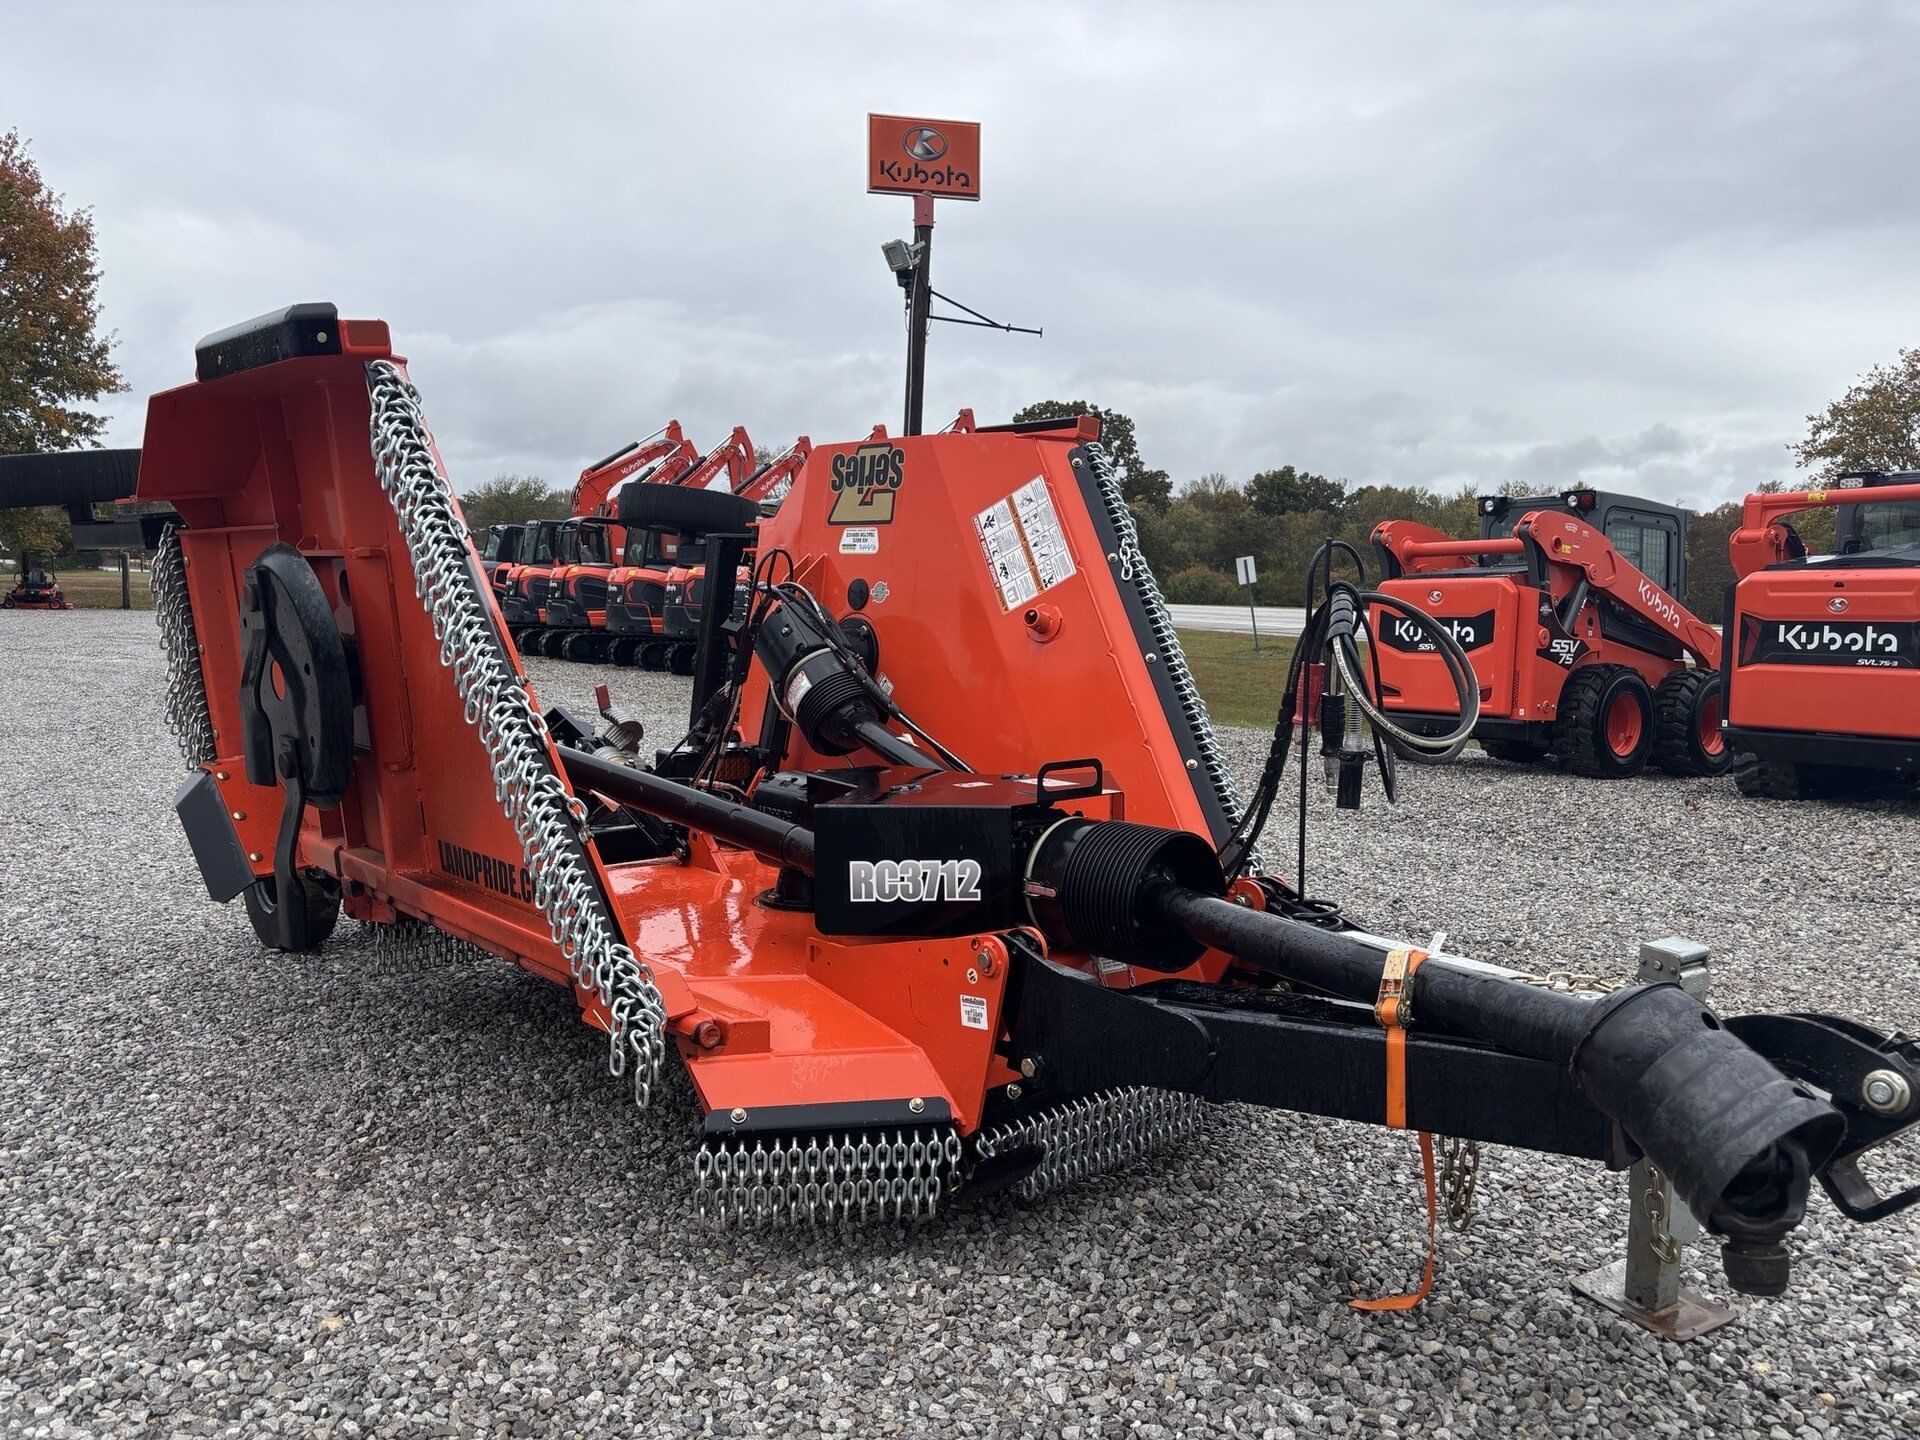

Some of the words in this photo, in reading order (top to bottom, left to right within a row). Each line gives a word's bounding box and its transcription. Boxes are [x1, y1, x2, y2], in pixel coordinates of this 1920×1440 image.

[879, 159, 971, 188] Kubota
[620, 458, 646, 475] Kubota
[830, 448, 905, 495] Series
[1638, 578, 1681, 629] Kubota
[1395, 619, 1475, 643] Kuta
[1778, 624, 1898, 653] Kubota
[1550, 639, 1581, 653] SSV
[1558, 653, 1574, 665] 75
[437, 839, 543, 906] LANDPRIDE.C
[849, 859, 982, 902] RC3712
